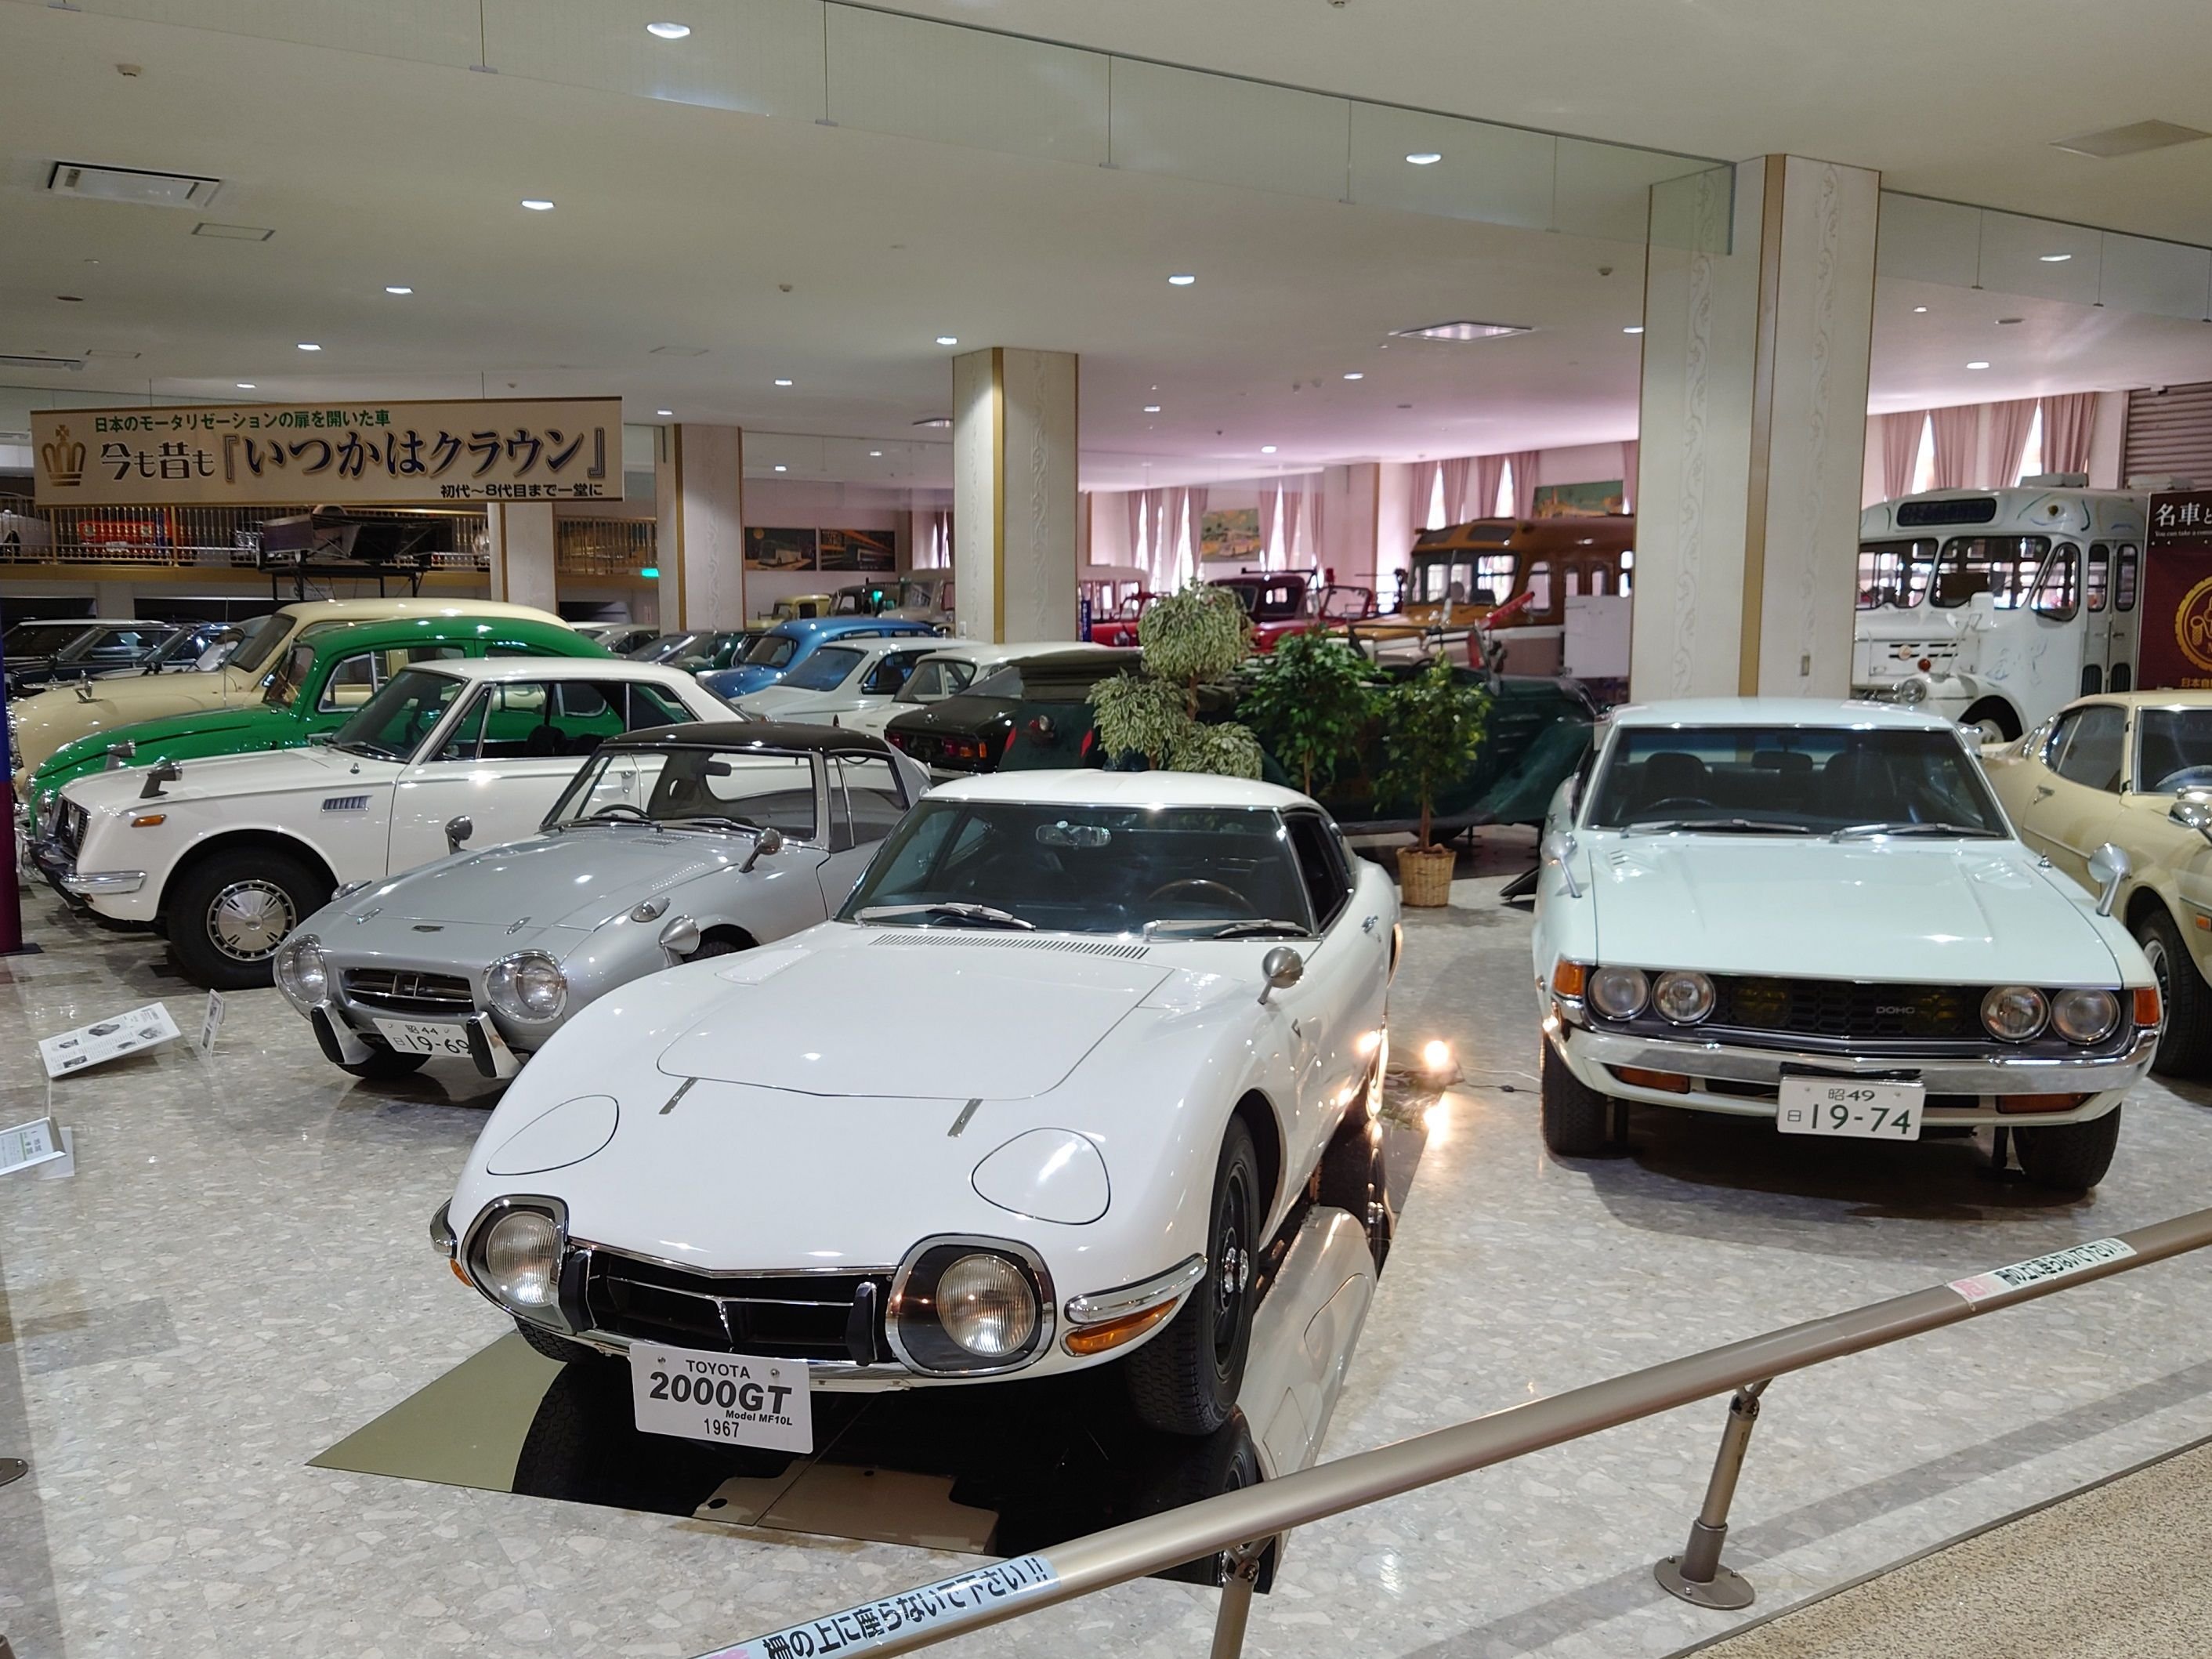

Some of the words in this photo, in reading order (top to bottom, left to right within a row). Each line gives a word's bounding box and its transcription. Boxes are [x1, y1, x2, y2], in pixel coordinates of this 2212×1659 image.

[95, 409, 391, 433] 日本のモータリゼーションの扉を開いた車
[2181, 677, 2212, 688] 日本自
[1812, 1103, 1910, 1134] 19-74
[686, 1360, 750, 1378] TOYOTA
[650, 1371, 792, 1414] 2000GT
[726, 1409, 755, 1421] Model
[758, 1413, 793, 1425] MF10L
[704, 1419, 740, 1437] 1967
